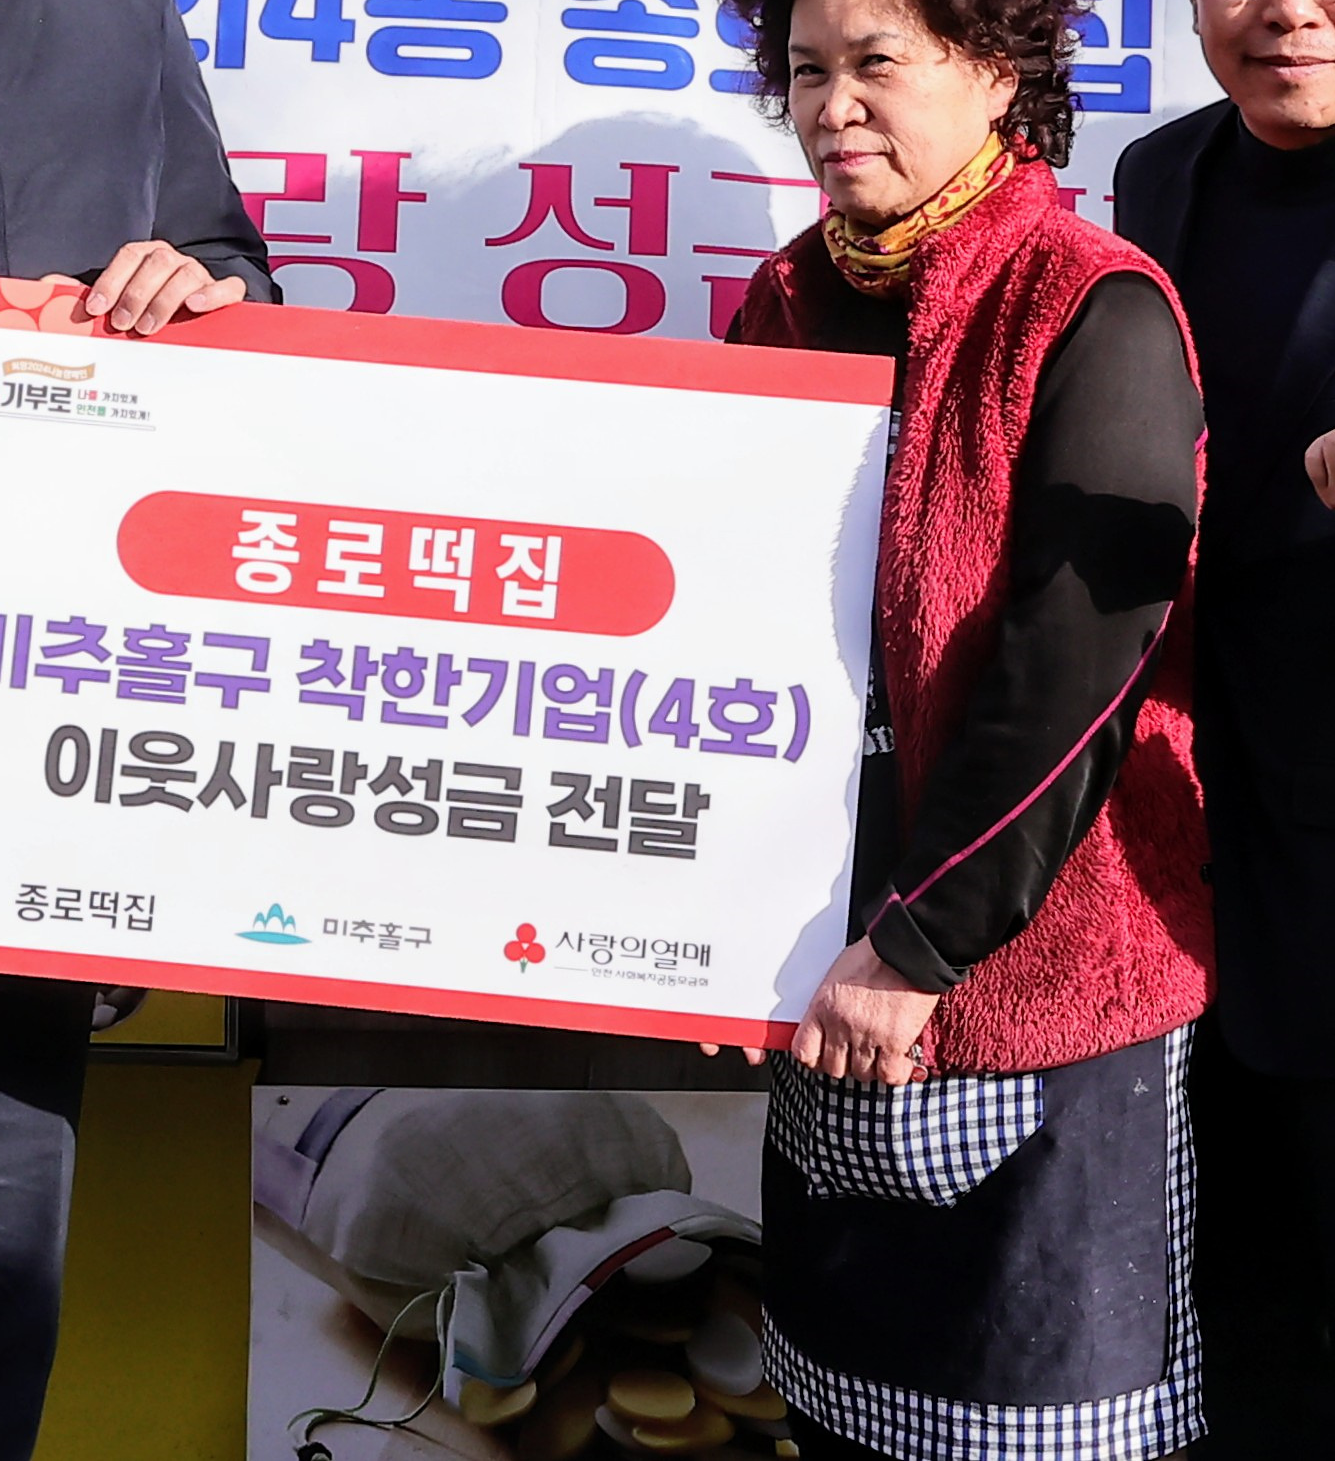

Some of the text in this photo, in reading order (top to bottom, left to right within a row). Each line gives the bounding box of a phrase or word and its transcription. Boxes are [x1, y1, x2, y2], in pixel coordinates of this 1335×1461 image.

[1, 382, 72, 413] 기부로
[231, 509, 562, 620] 종로떡집
[296, 638, 812, 763] 착한기업(4호)
[44, 724, 710, 859] 이웃사랑성금 전달
[14, 883, 711, 971] 종로떡집 미추홀구 사랑의열매
